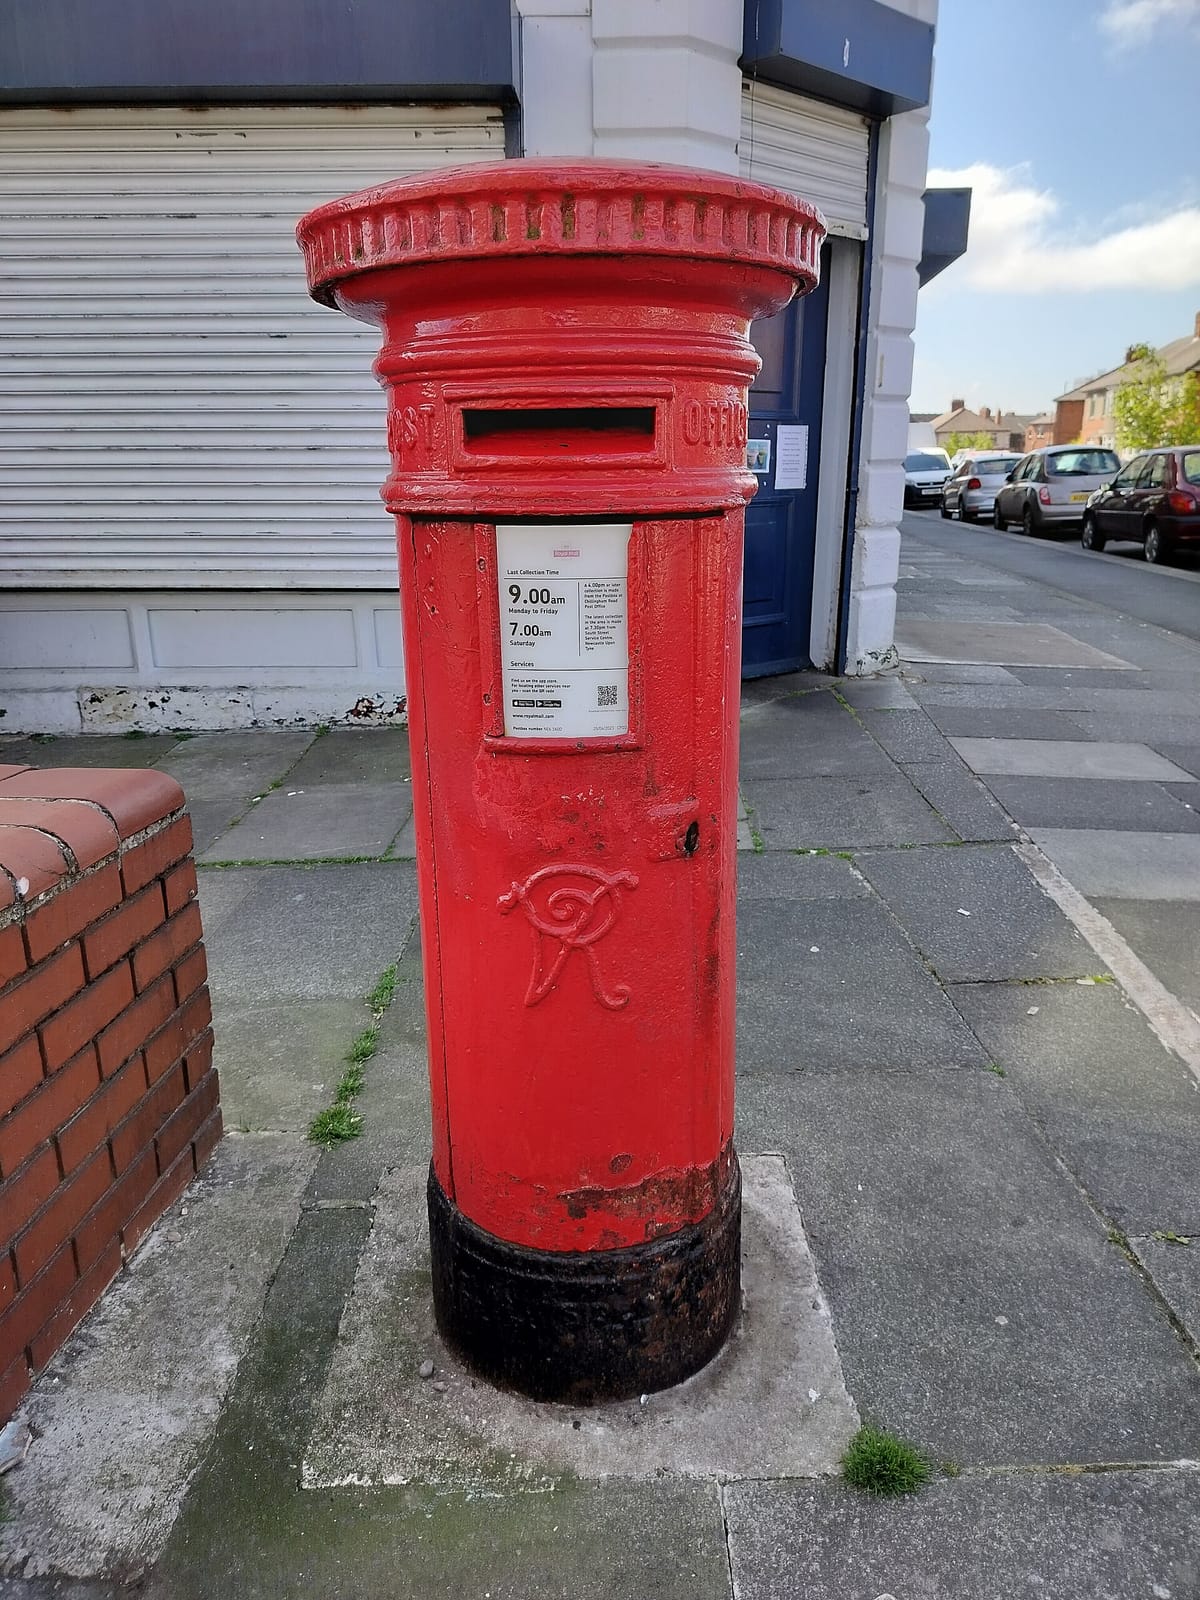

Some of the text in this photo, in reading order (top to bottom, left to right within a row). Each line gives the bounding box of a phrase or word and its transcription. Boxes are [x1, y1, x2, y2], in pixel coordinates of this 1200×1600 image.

[388, 404, 436, 452] OST
[682, 397, 748, 448] OFFIC
[508, 584, 566, 604] 9.00am
[508, 607, 531, 615] Monday
[540, 607, 558, 615] Friday
[509, 622, 552, 637] 7.00am
[509, 639, 536, 647] Saturday
